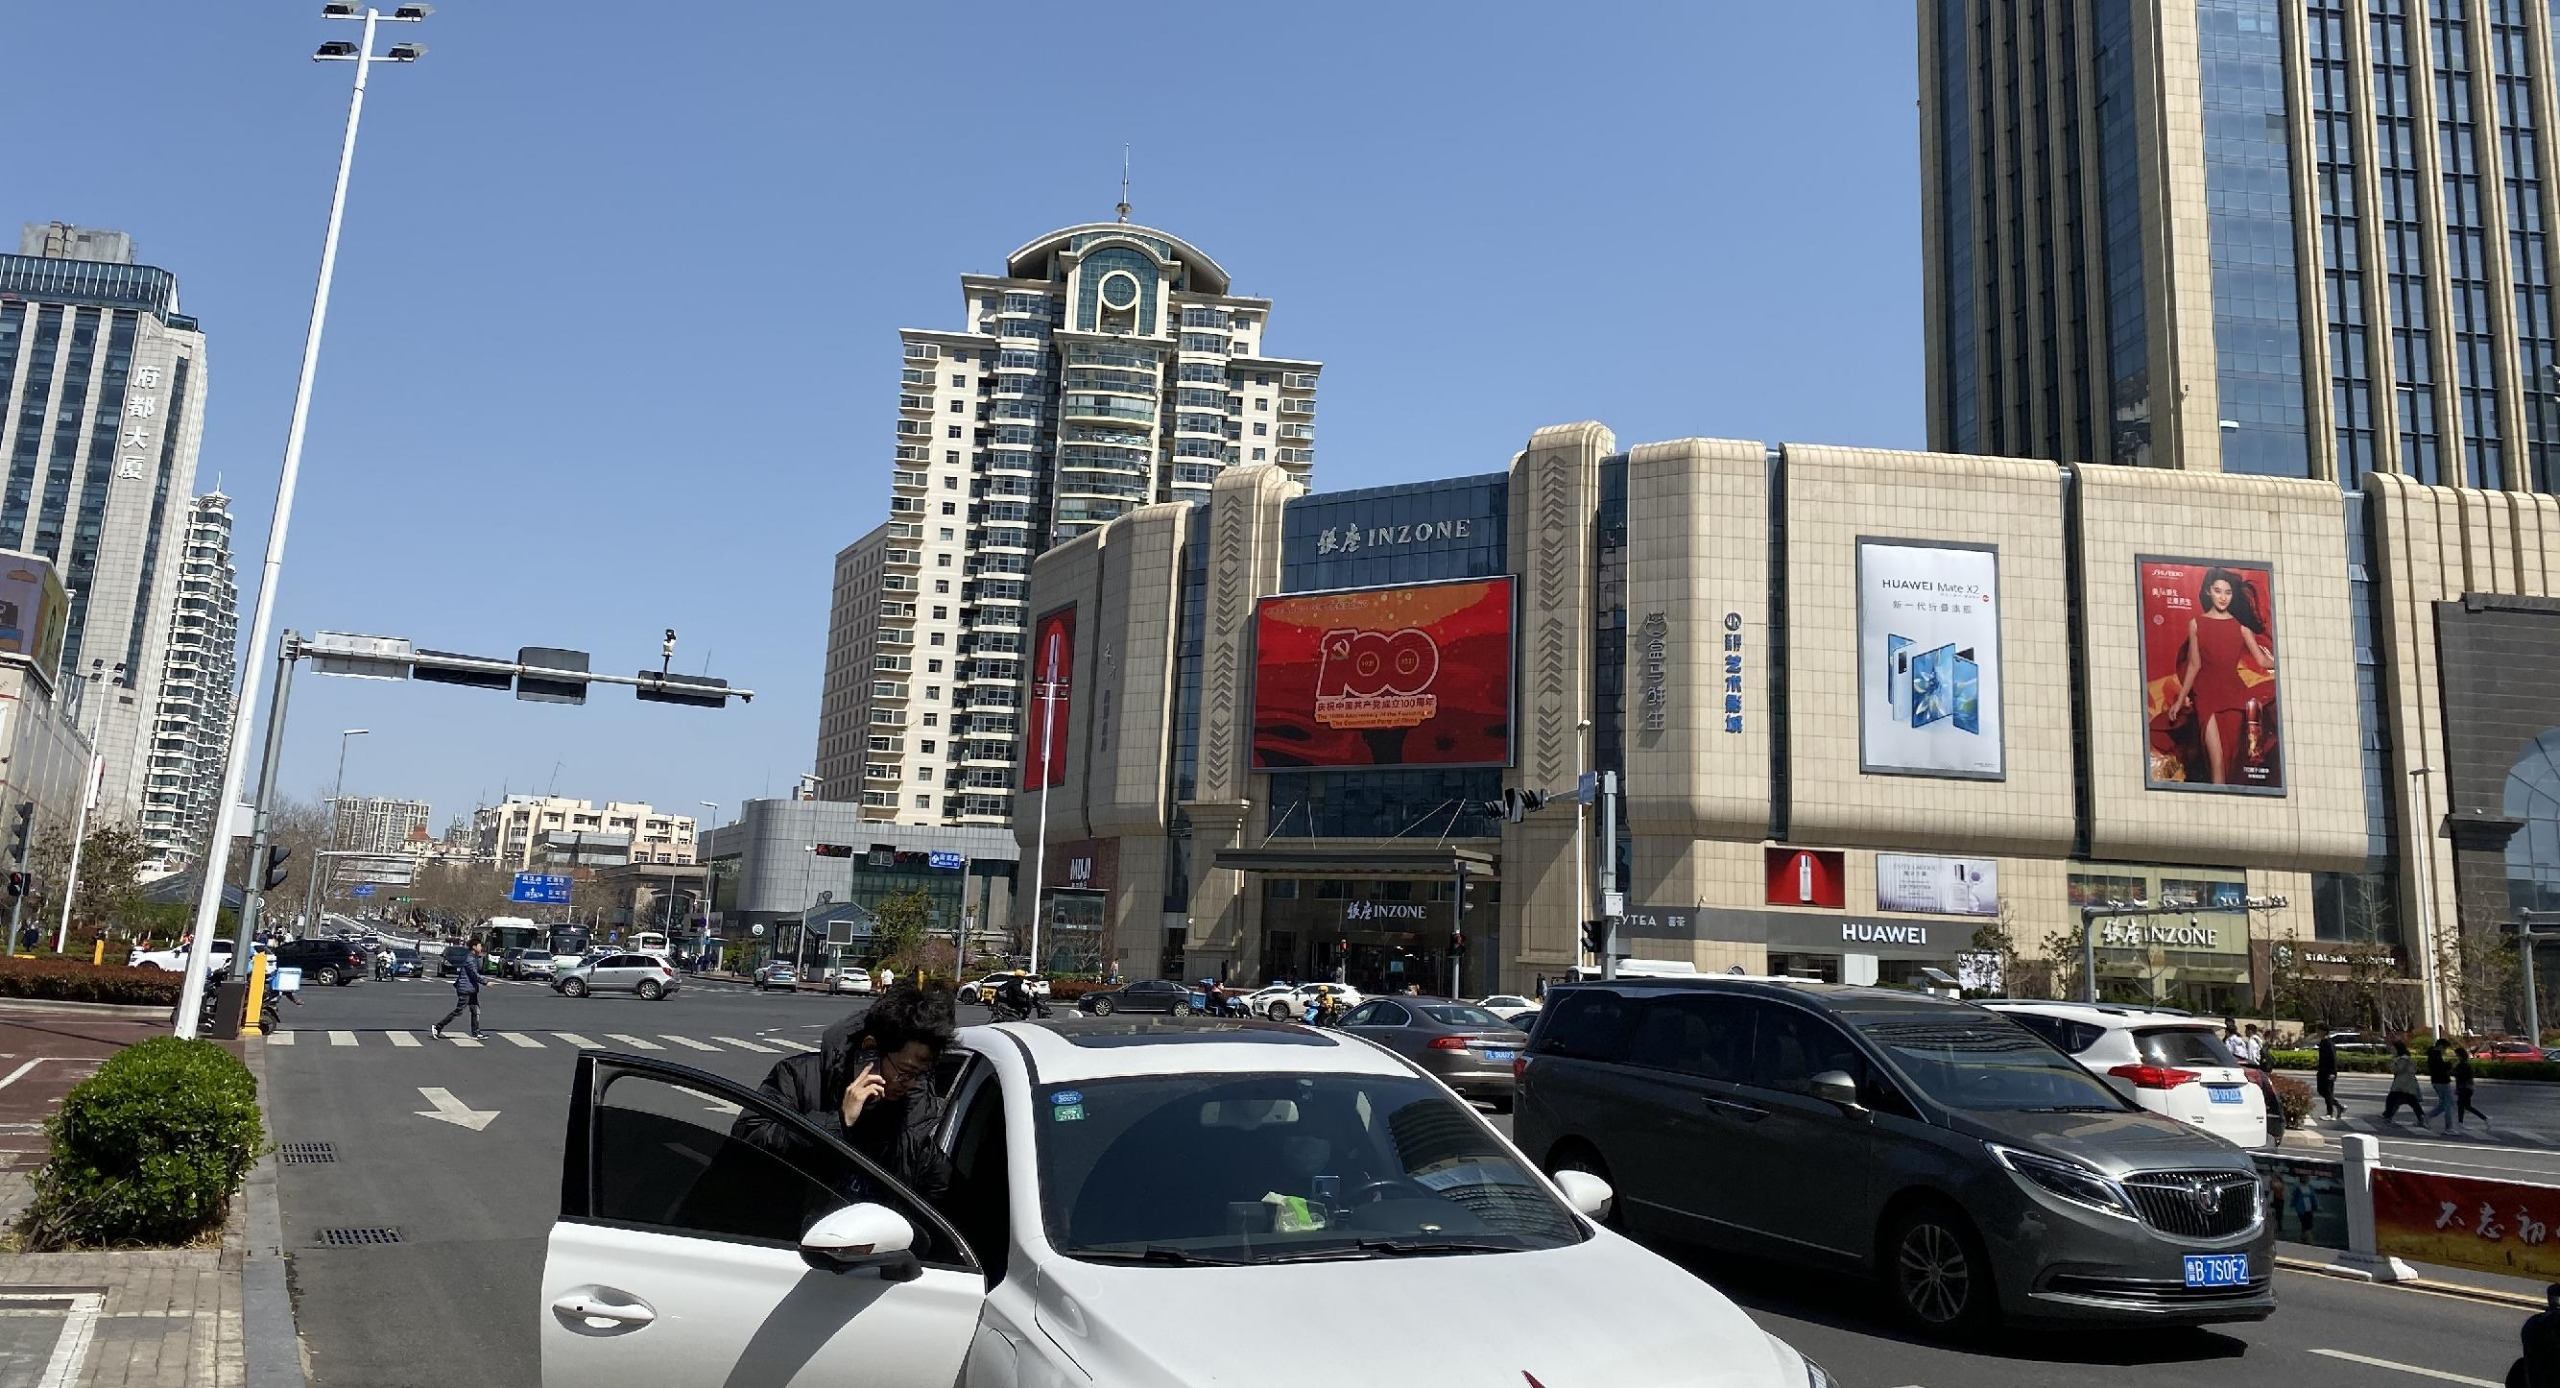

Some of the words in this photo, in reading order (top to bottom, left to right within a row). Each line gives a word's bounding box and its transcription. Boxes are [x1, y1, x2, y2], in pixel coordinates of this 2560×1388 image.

[117, 365, 161, 481] 府都大厦
[1368, 519, 1471, 547] INZONE
[1882, 579, 1933, 591] HUAWEI
[1937, 582, 1964, 593] Mate
[1966, 584, 1979, 594] X2
[1070, 857, 1091, 880] MUJI
[1374, 904, 1427, 919] INZONE
[1842, 923, 1926, 945] HUAWEI
[2144, 925, 2218, 945] INZONE
[2435, 1200, 2560, 1245] 不忘初
